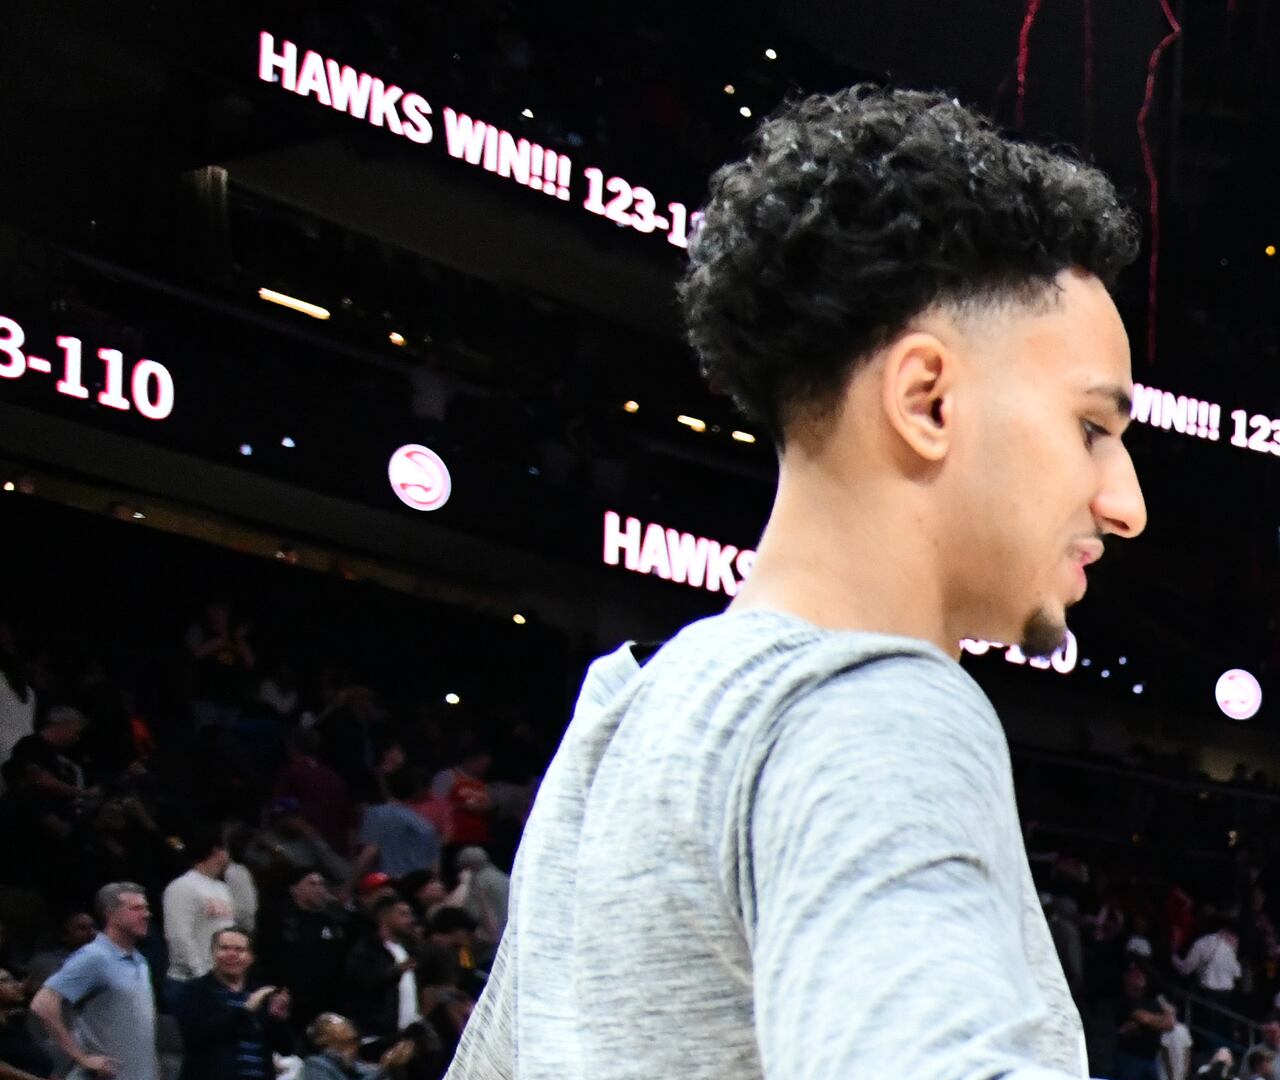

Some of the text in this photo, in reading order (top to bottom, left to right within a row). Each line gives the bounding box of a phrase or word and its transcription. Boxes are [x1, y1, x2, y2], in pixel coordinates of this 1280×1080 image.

[259, 31, 434, 144] HAWKS
[443, 106, 573, 201] WIN!!!
[1130, 383, 1221, 441] WIN!!!
